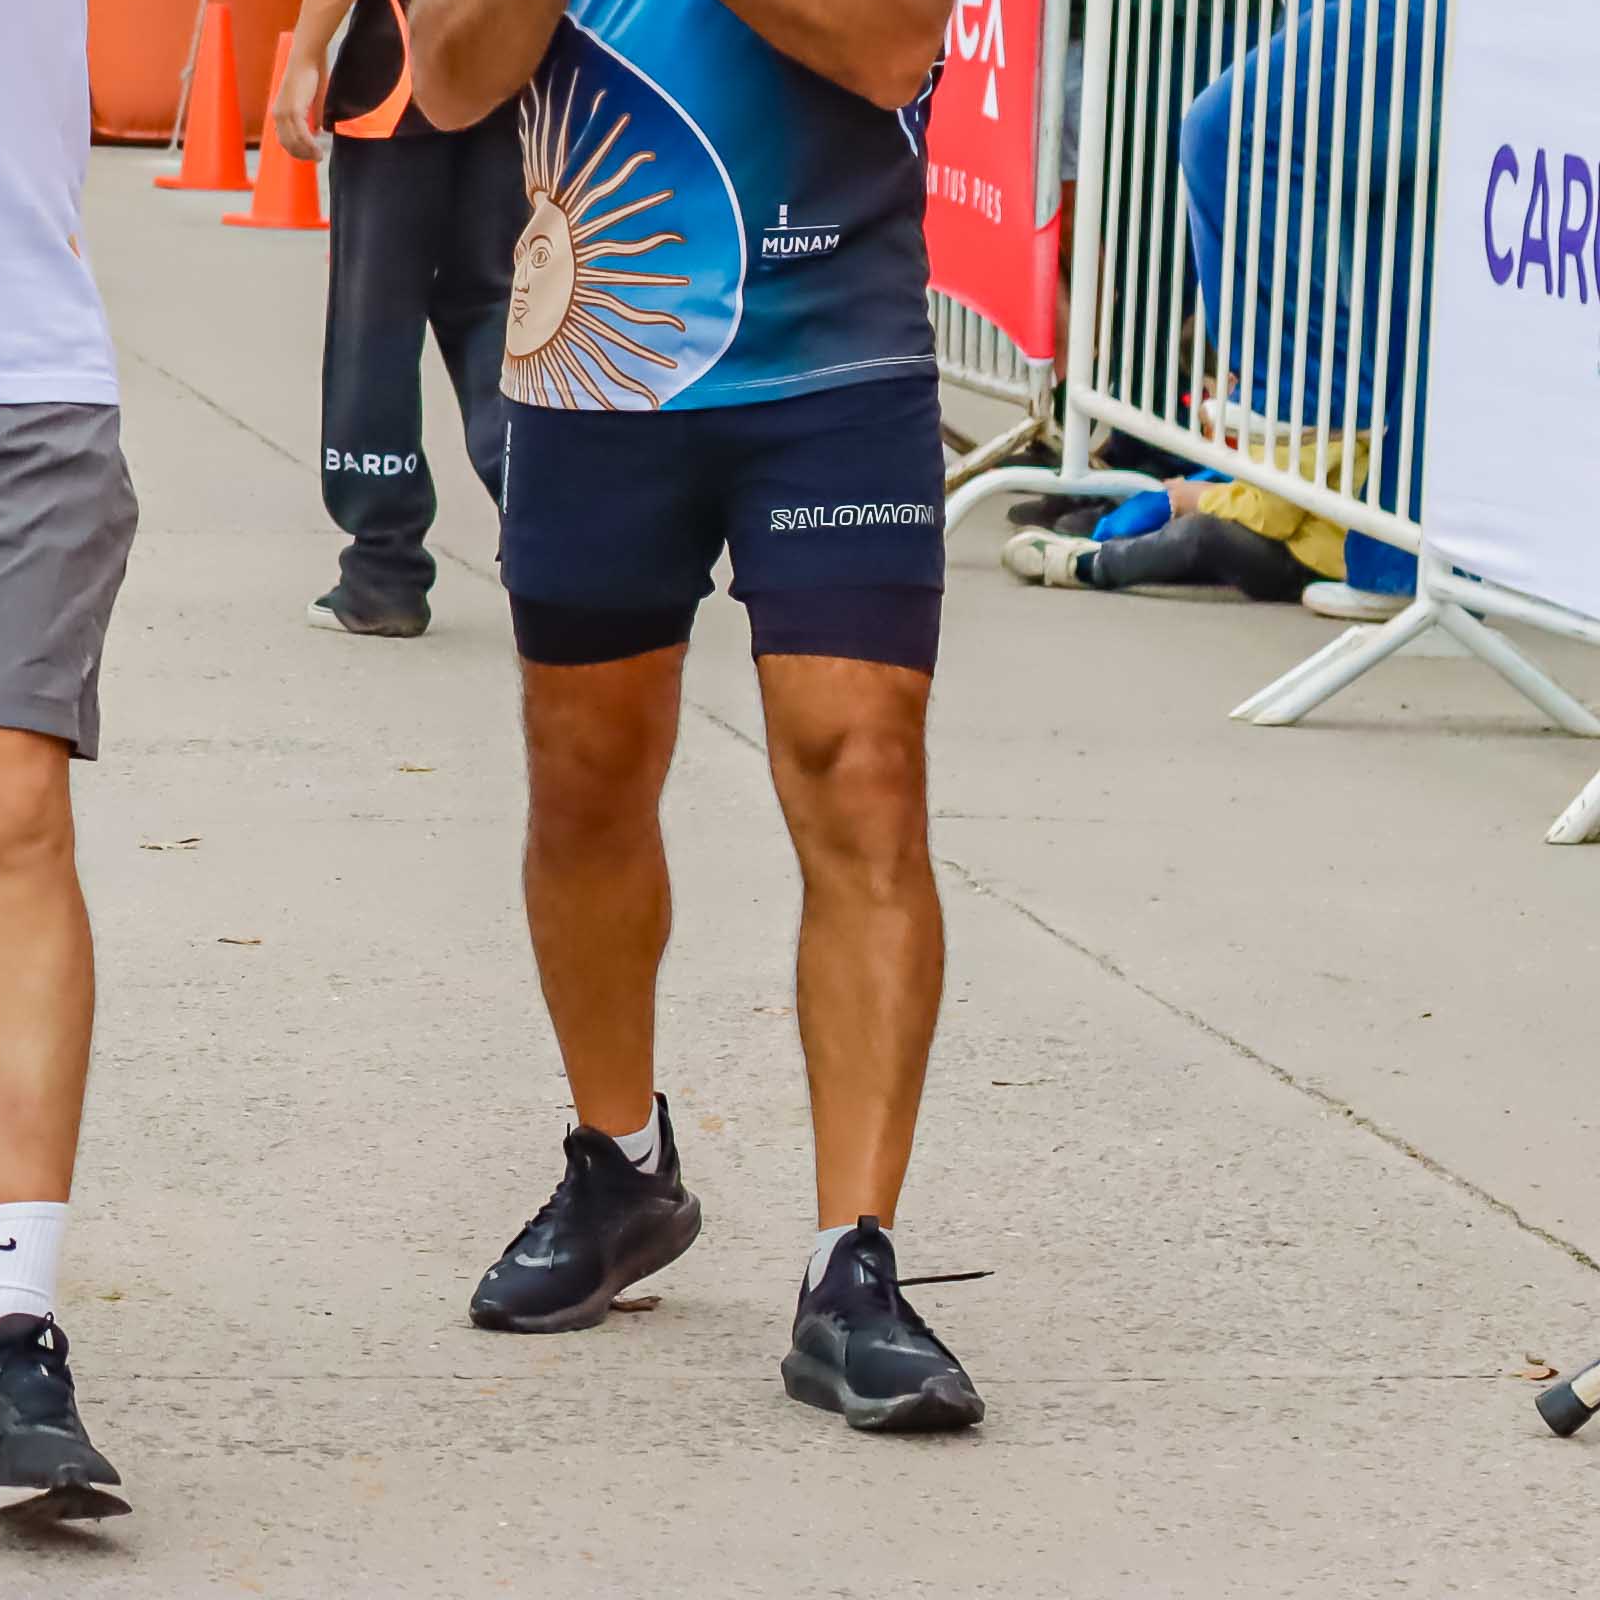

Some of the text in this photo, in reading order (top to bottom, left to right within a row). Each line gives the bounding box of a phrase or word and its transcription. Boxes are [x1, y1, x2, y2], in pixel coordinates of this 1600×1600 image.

[943, 166, 967, 204] TUS
[972, 177, 1002, 225] PIES
[1484, 143, 1600, 305] CAR
[762, 234, 840, 254] MUNAM
[325, 447, 418, 476] BARDO
[770, 503, 934, 532] SALOMON
